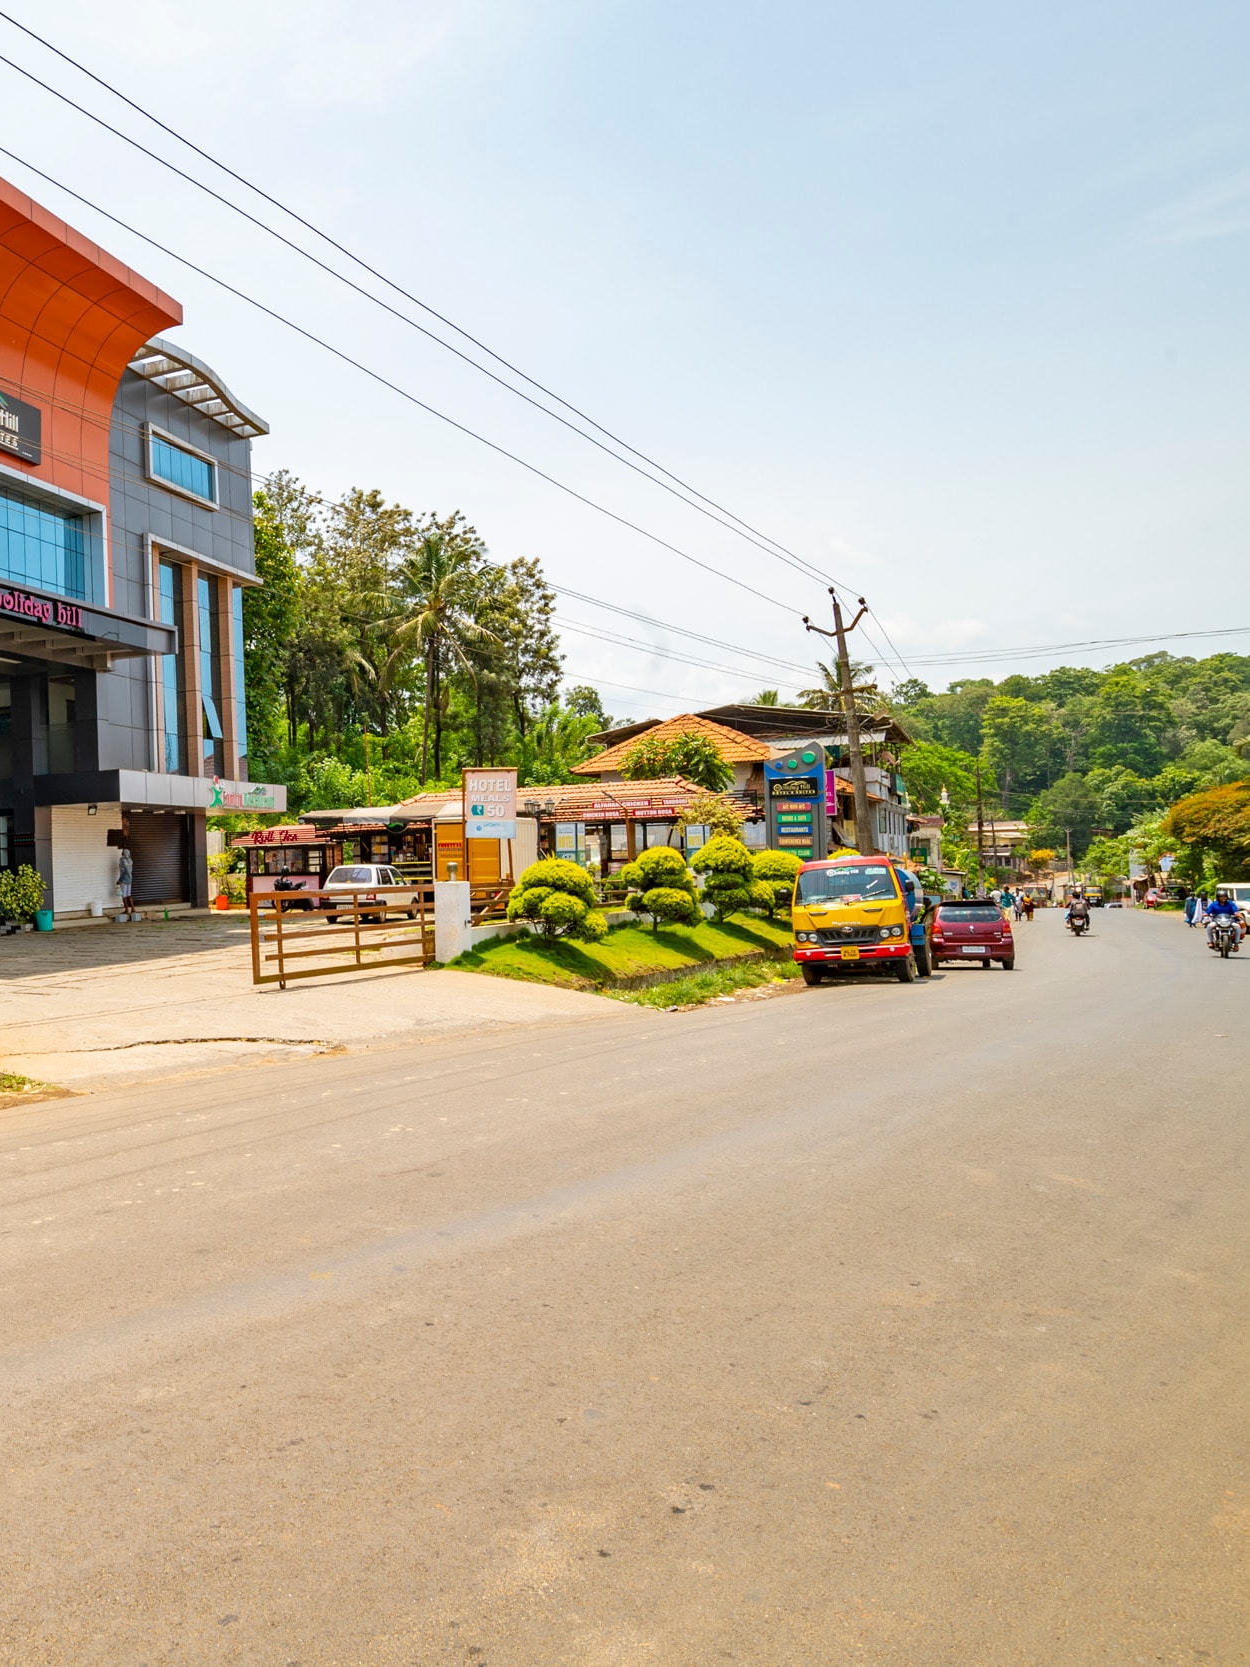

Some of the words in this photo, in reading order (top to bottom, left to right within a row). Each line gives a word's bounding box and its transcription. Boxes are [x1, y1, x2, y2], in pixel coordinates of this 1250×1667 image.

[56, 601, 83, 628] hill
[469, 779, 513, 792] HOTEL
[471, 794, 511, 803] MEALS
[487, 804, 506, 817] 50
